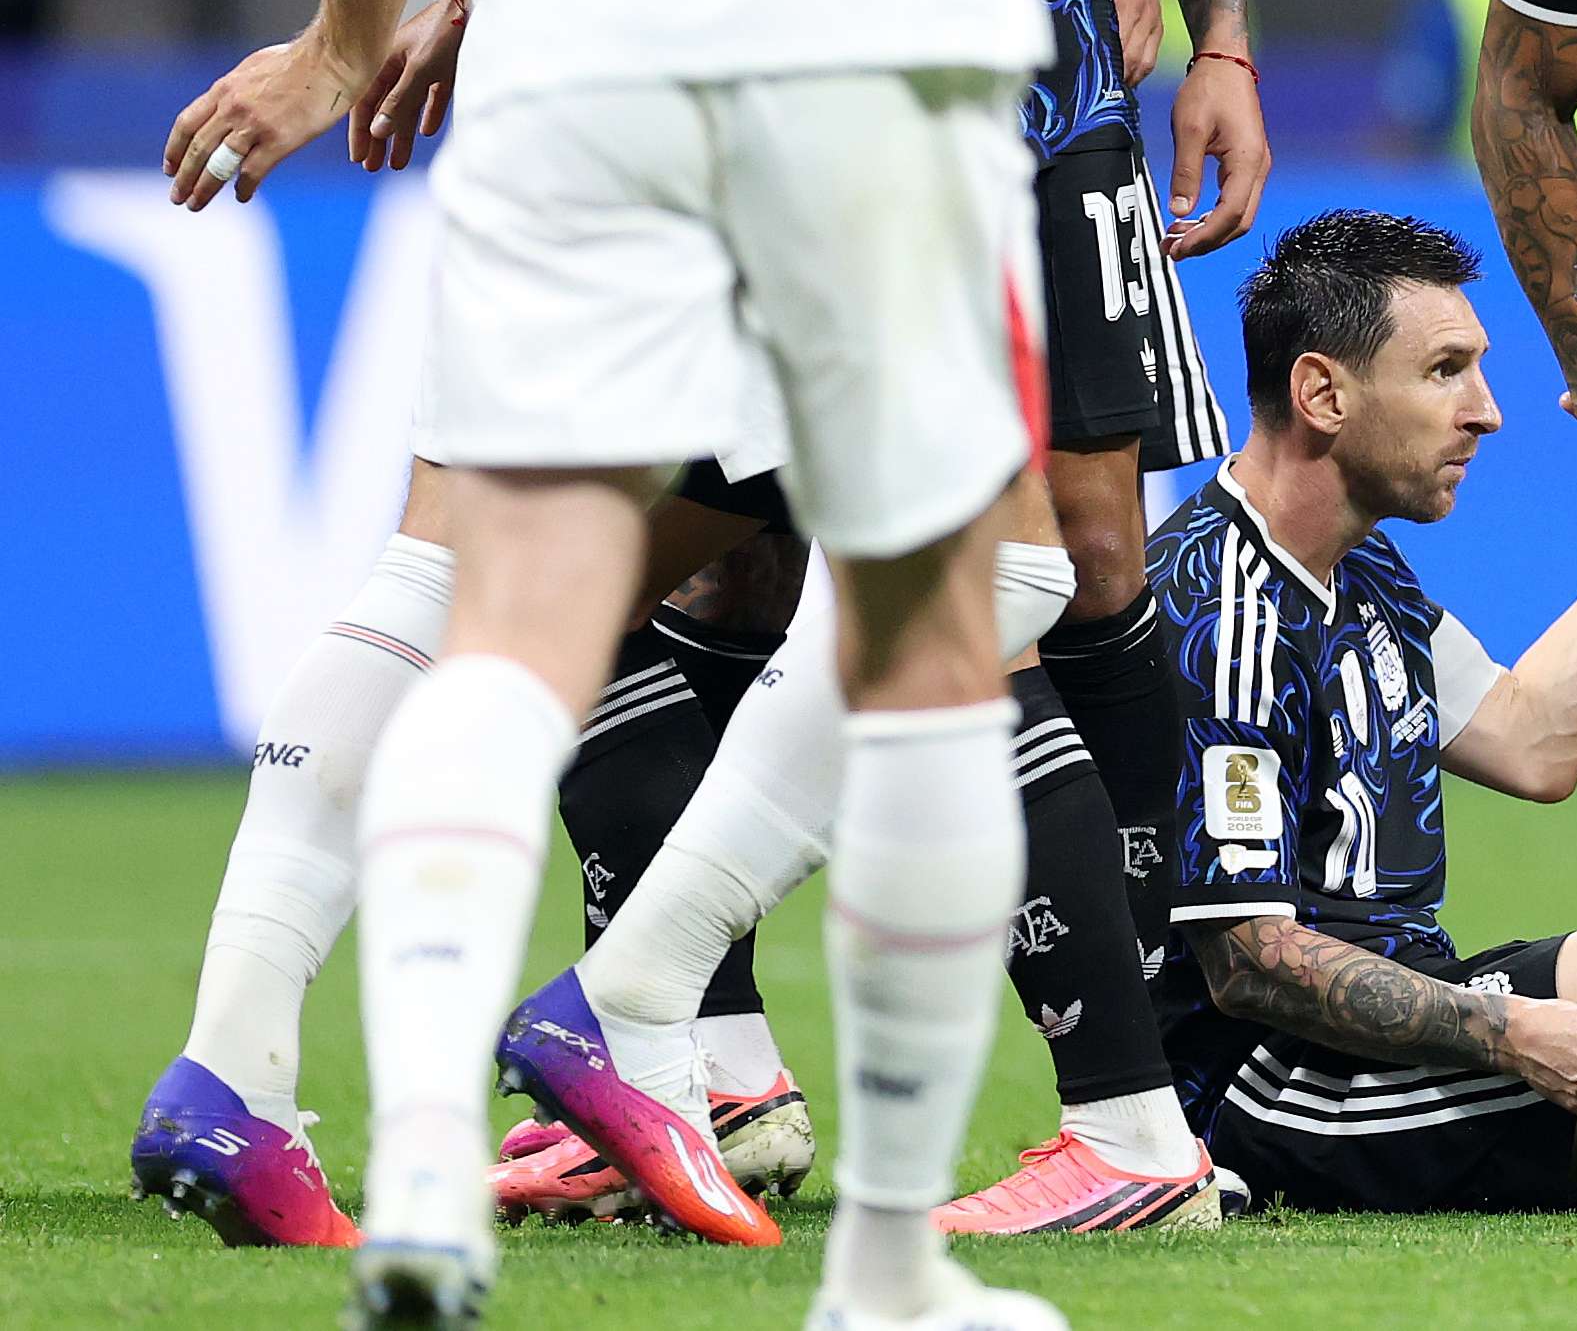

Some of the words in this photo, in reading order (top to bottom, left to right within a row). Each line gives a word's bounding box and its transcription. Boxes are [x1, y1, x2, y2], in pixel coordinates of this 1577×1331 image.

[1082, 184, 1149, 321] 13
[1227, 823, 1263, 831] 2026
[1235, 801, 1254, 809] FIFA
[1117, 828, 1162, 879] FA
[1322, 770, 1377, 899] 10
